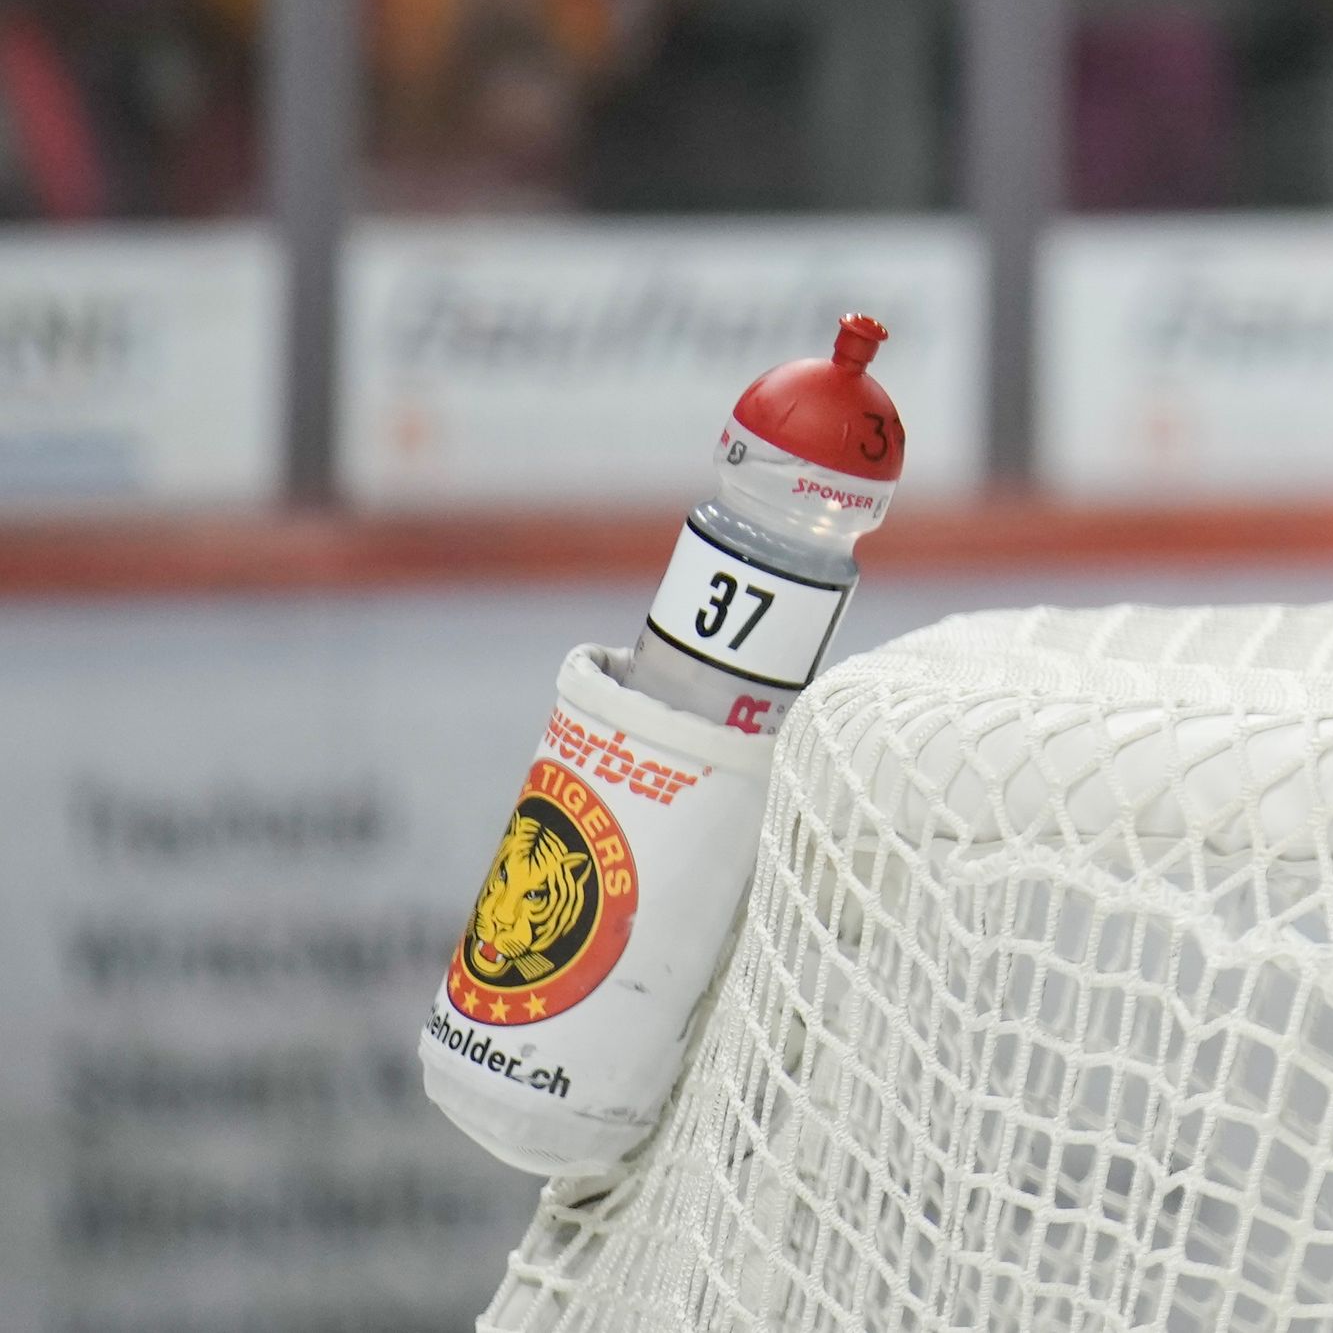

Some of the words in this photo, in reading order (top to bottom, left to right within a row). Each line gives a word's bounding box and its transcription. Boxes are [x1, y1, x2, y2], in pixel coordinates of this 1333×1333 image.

[860, 412, 905, 463] 3
[791, 477, 874, 511] SPONSER
[695, 570, 776, 652] 37
[536, 763, 633, 898] TIGERS
